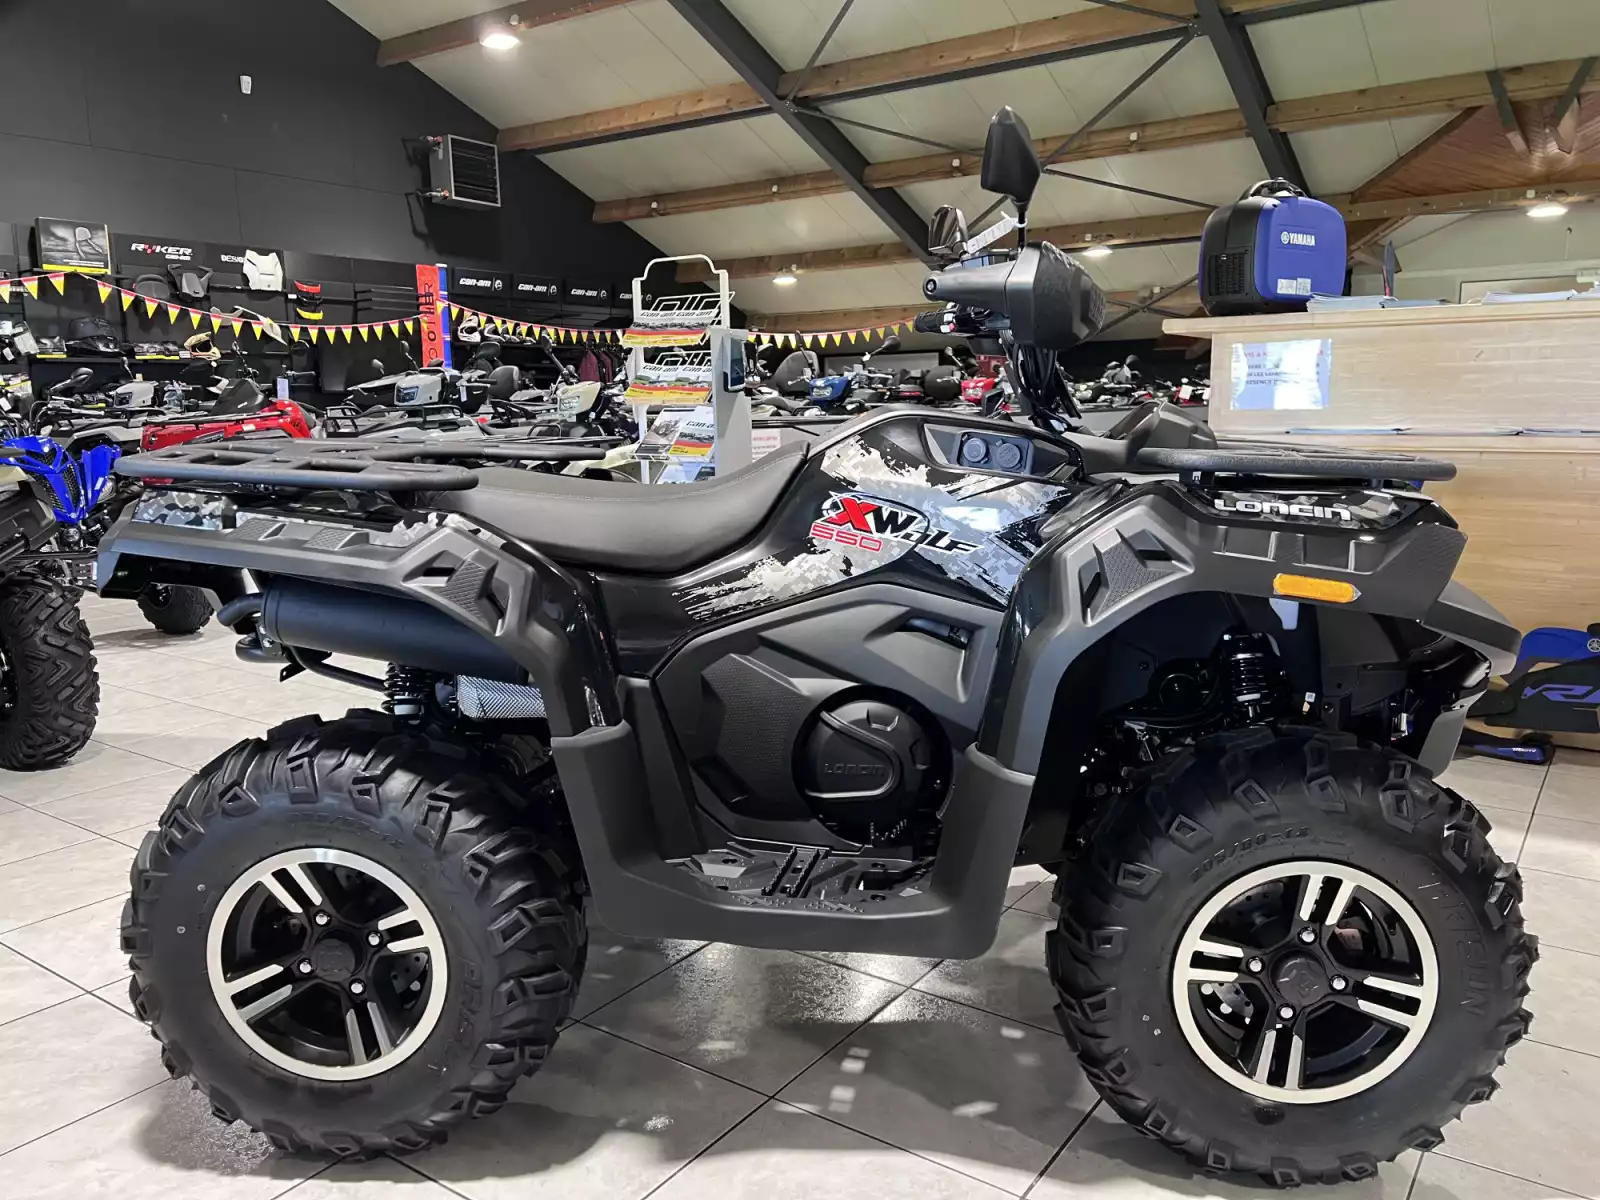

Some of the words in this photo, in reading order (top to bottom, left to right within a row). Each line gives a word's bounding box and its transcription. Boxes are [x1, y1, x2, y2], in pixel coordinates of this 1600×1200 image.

[1289, 232, 1316, 247] YAMAHA
[130, 243, 193, 256] RYKER
[220, 254, 244, 263] DESIG
[458, 277, 492, 288] can-am
[517, 283, 548, 293] can-am
[570, 288, 599, 298] can-am
[642, 364, 679, 373] can-am
[685, 419, 714, 428] can-a
[1214, 499, 1351, 521] LONCIN
[811, 524, 882, 551] 550
